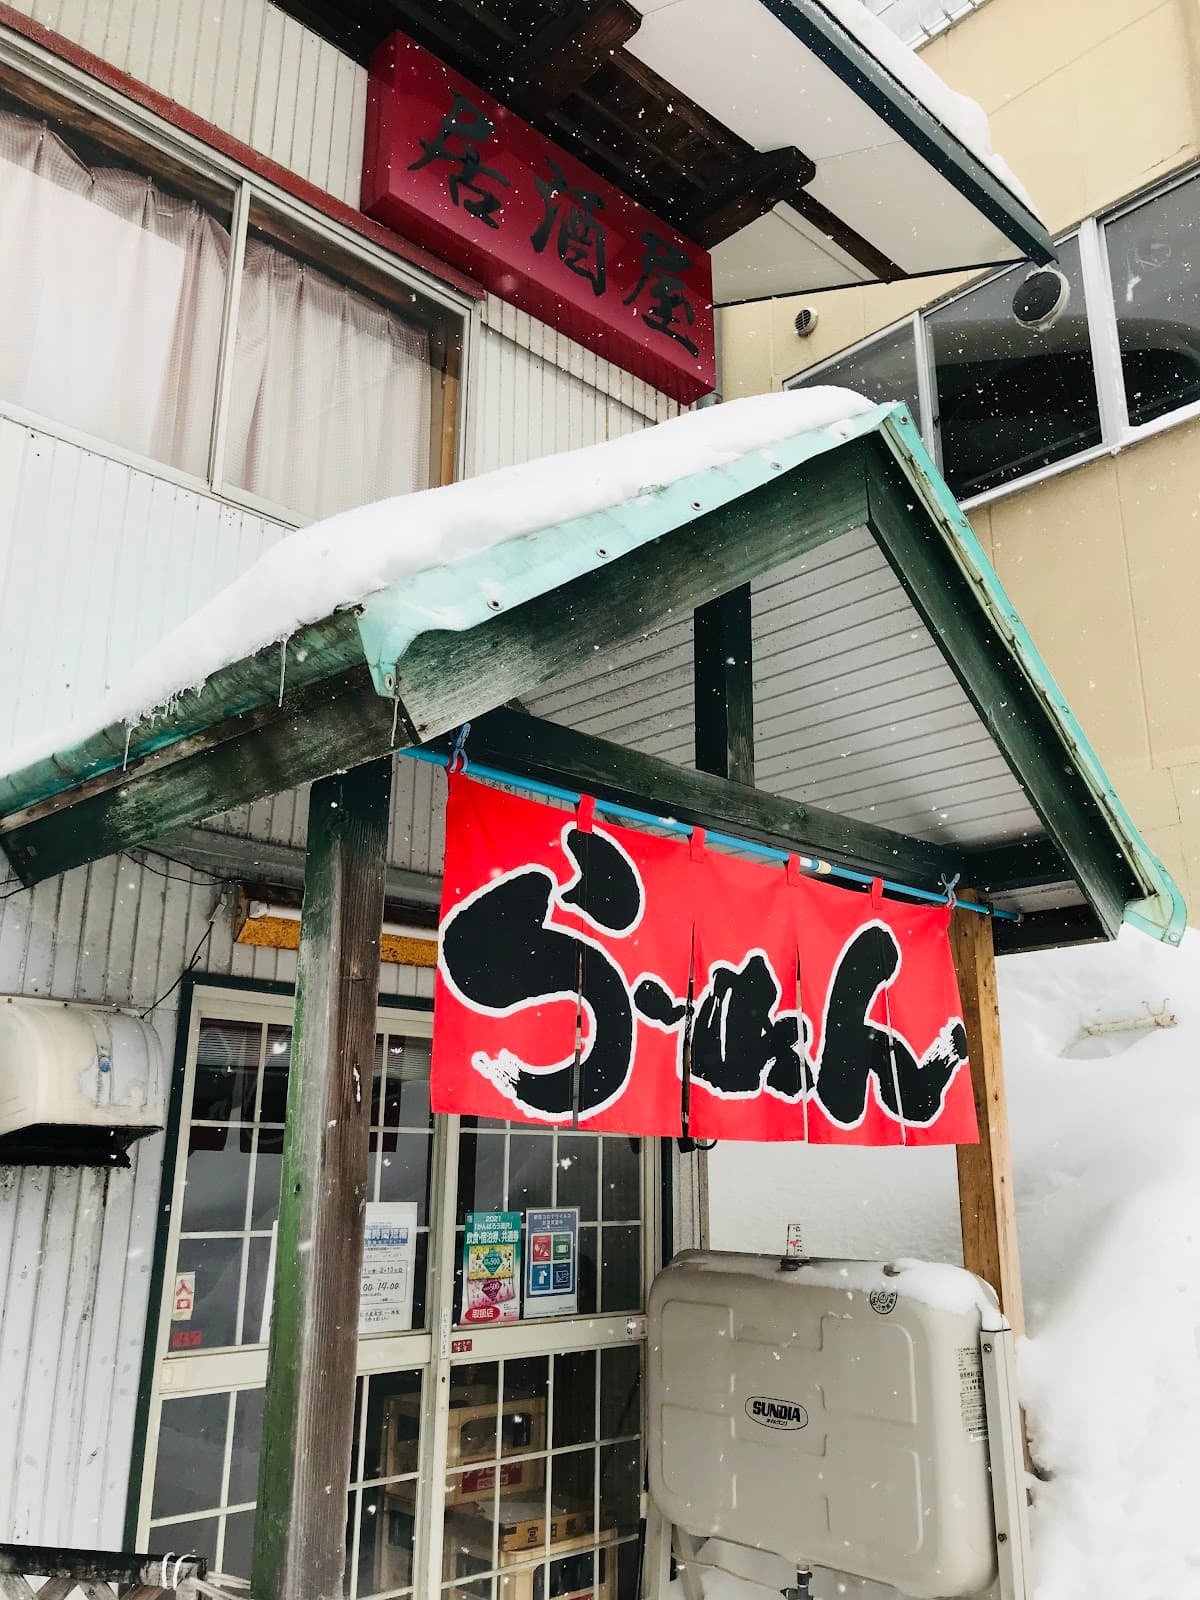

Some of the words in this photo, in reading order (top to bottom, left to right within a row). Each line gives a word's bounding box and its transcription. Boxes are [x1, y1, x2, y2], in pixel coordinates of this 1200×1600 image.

[407, 87, 700, 358] 居酒屋
[176, 1279, 193, 1310] 入口
[752, 1400, 801, 1423] SUNDIA
